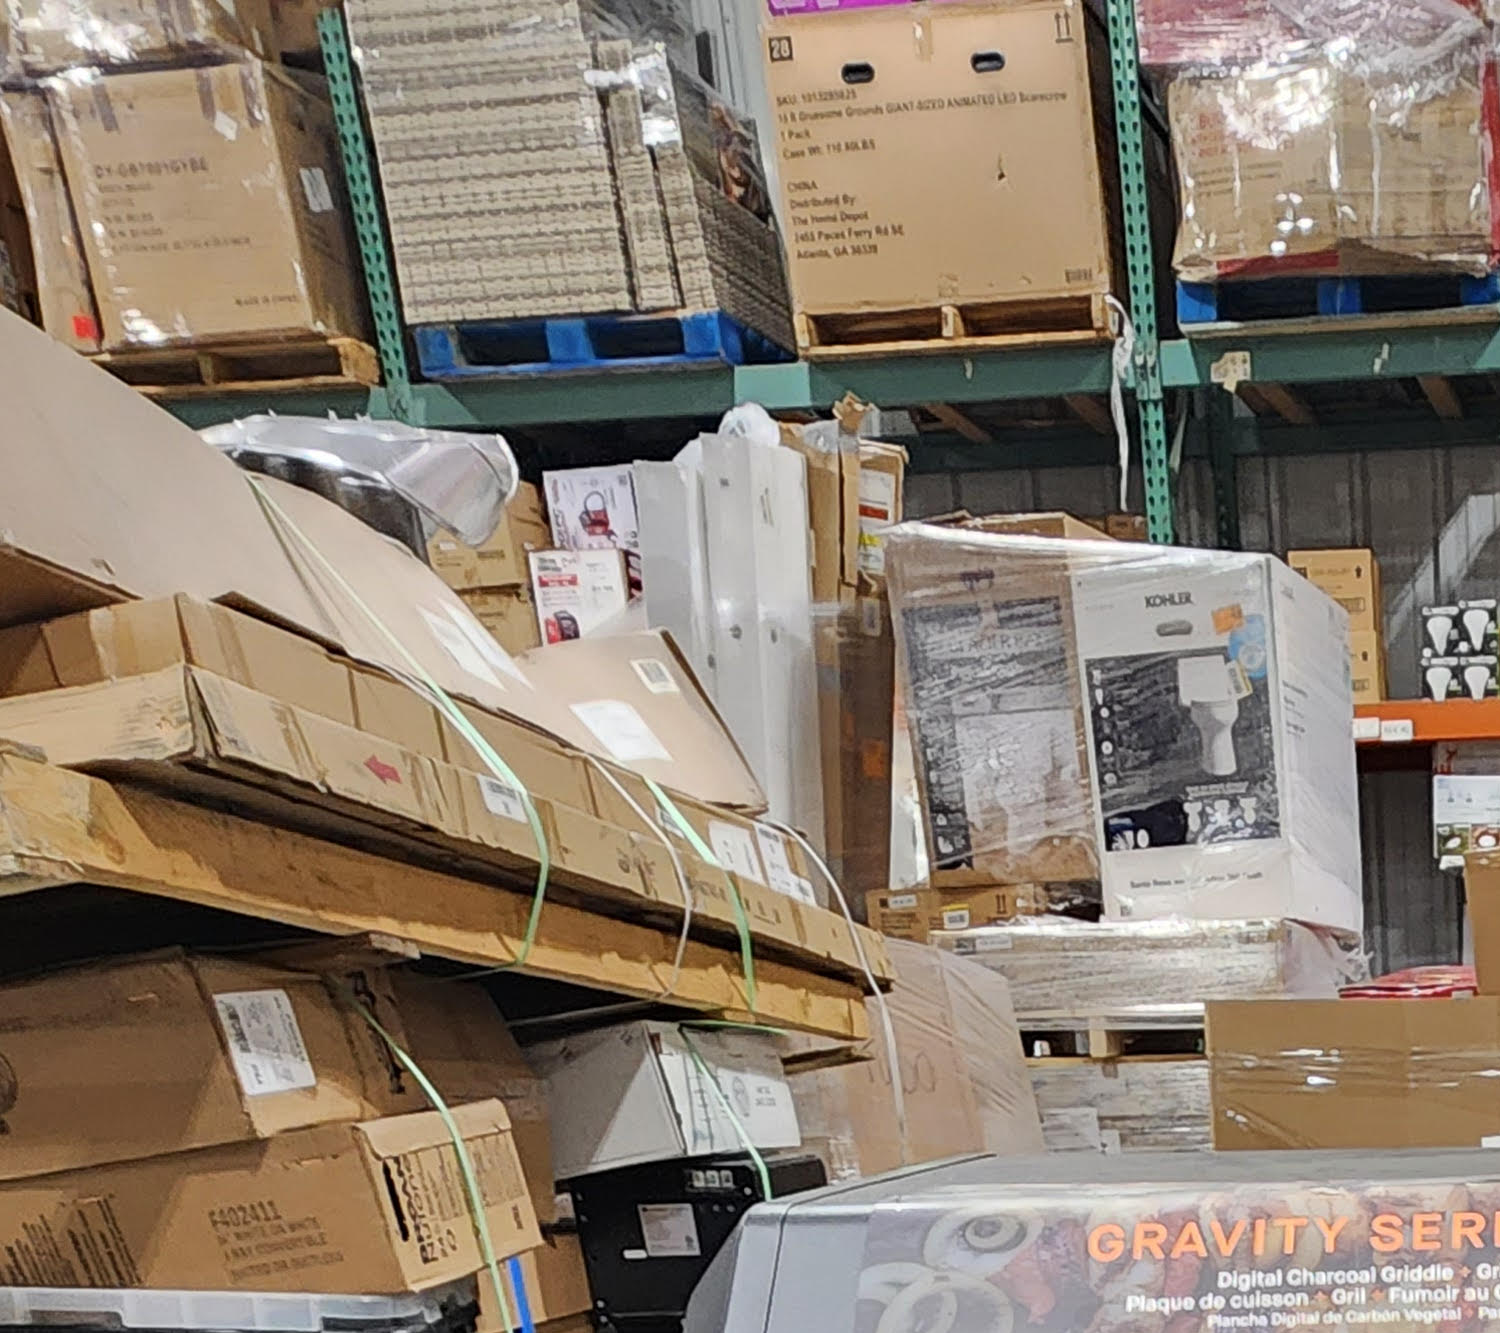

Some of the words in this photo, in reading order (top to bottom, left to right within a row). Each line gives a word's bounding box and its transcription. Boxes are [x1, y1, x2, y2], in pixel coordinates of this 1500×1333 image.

[1144, 591, 1194, 608] KOHLER
[1087, 1215, 1349, 1264] GRAVITY
[1217, 1268, 1282, 1292] Digital
[1286, 1265, 1376, 1286] Charcoal
[1381, 1263, 1454, 1285] Griddle
[1126, 1294, 1195, 1316] Plaque
[1199, 1292, 1225, 1310] de
[1230, 1289, 1309, 1309] cuisson
[1331, 1288, 1366, 1306] Gril
[1389, 1283, 1458, 1304] Fumoir
[1464, 1286, 1489, 1301] au
[1207, 1312, 1268, 1329] Plancha
[1271, 1311, 1320, 1328] Digital
[1323, 1310, 1343, 1324] de
